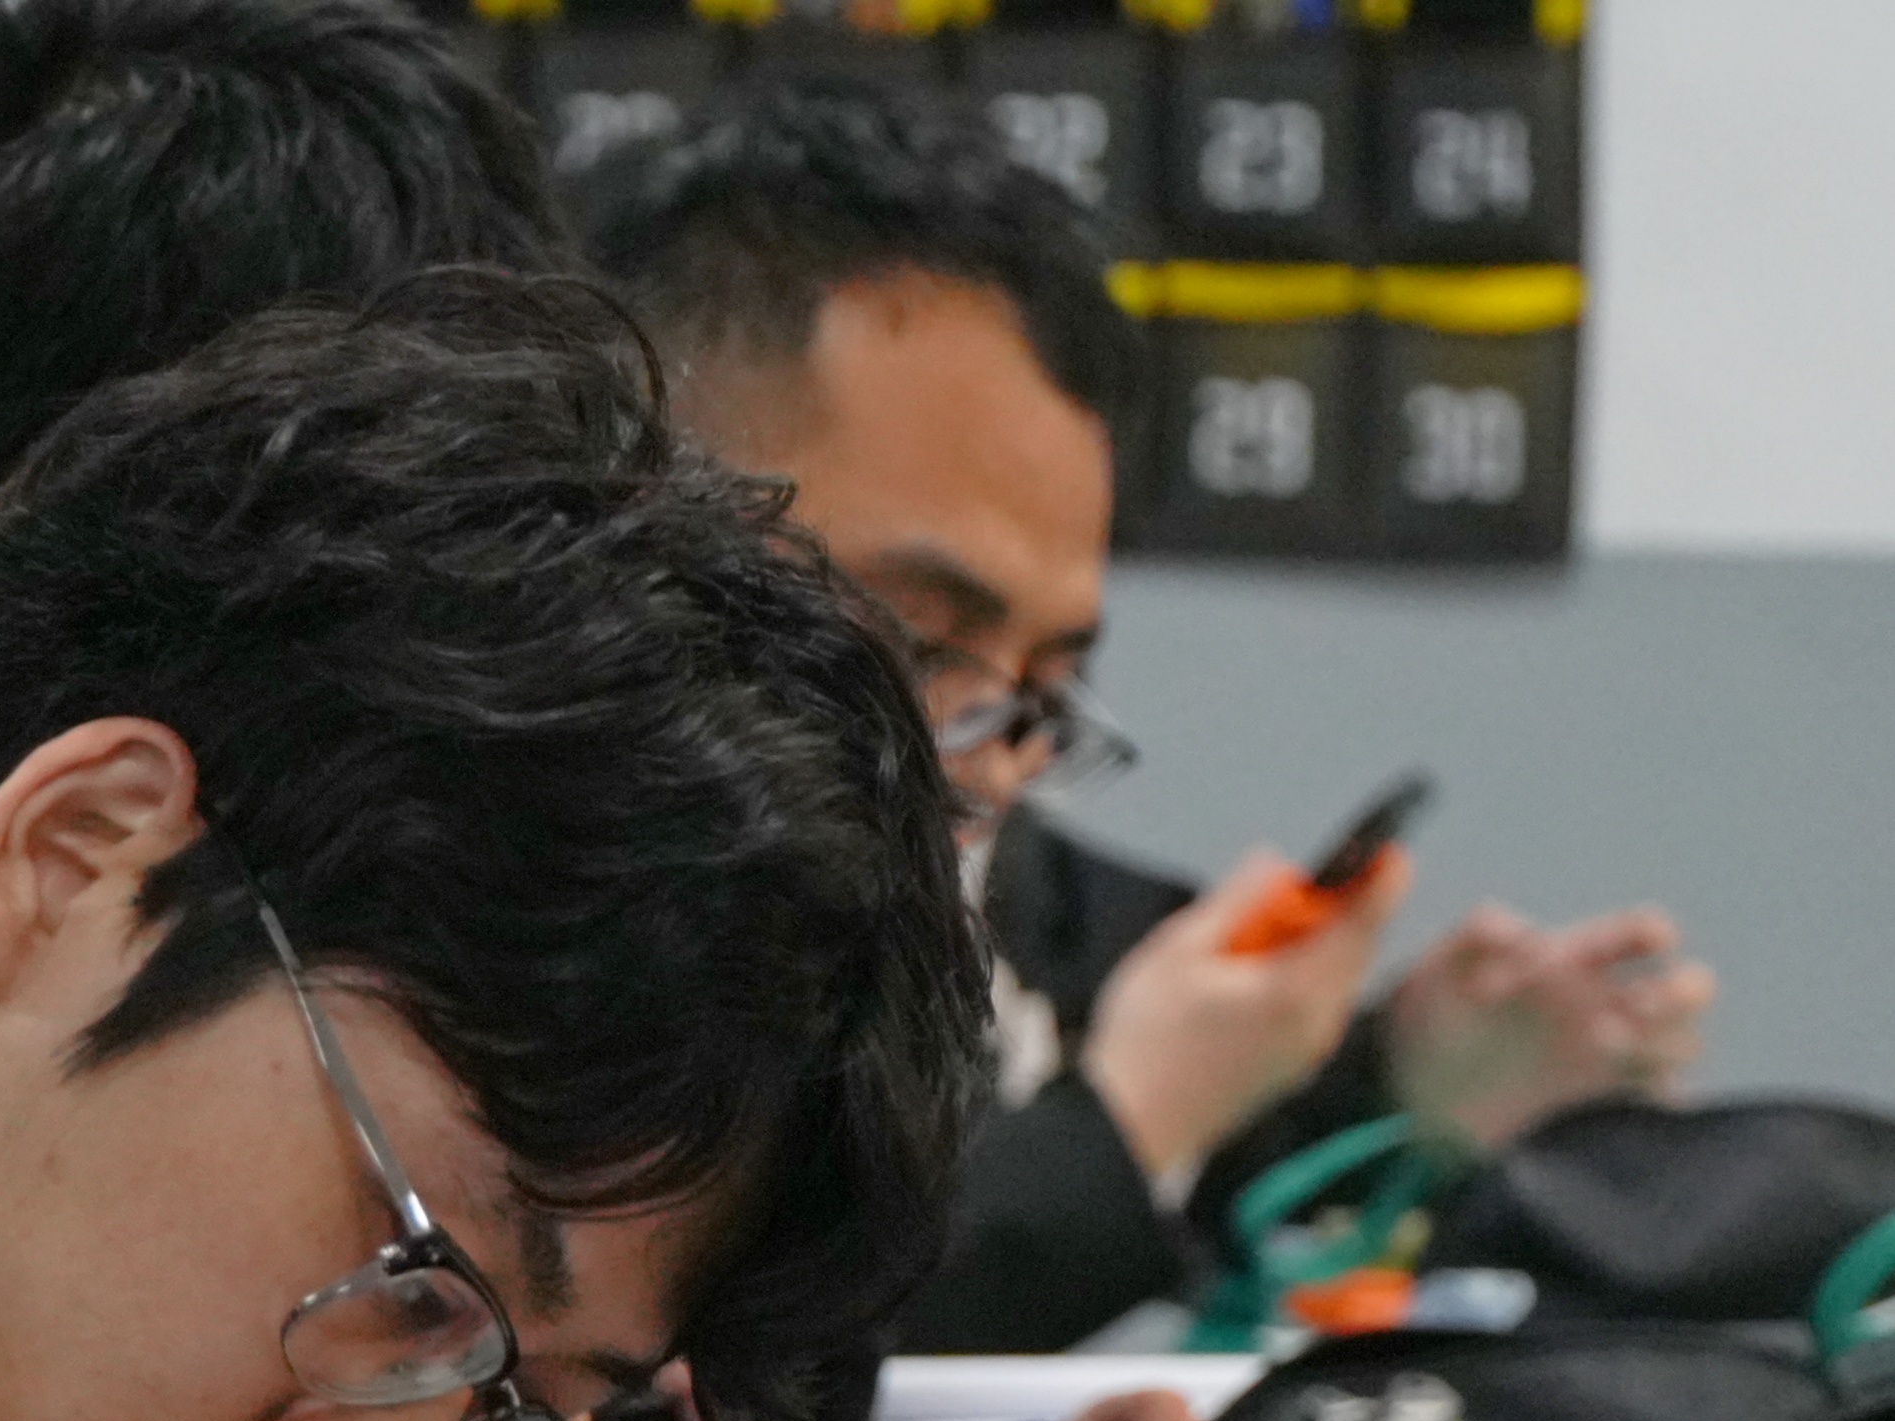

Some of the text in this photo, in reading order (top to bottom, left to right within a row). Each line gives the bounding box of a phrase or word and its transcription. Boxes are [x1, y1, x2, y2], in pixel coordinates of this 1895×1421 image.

[1199, 97, 1325, 215] 23
[1410, 106, 1532, 221] 24
[1187, 375, 1315, 499] 29
[1403, 382, 1527, 505] 30
